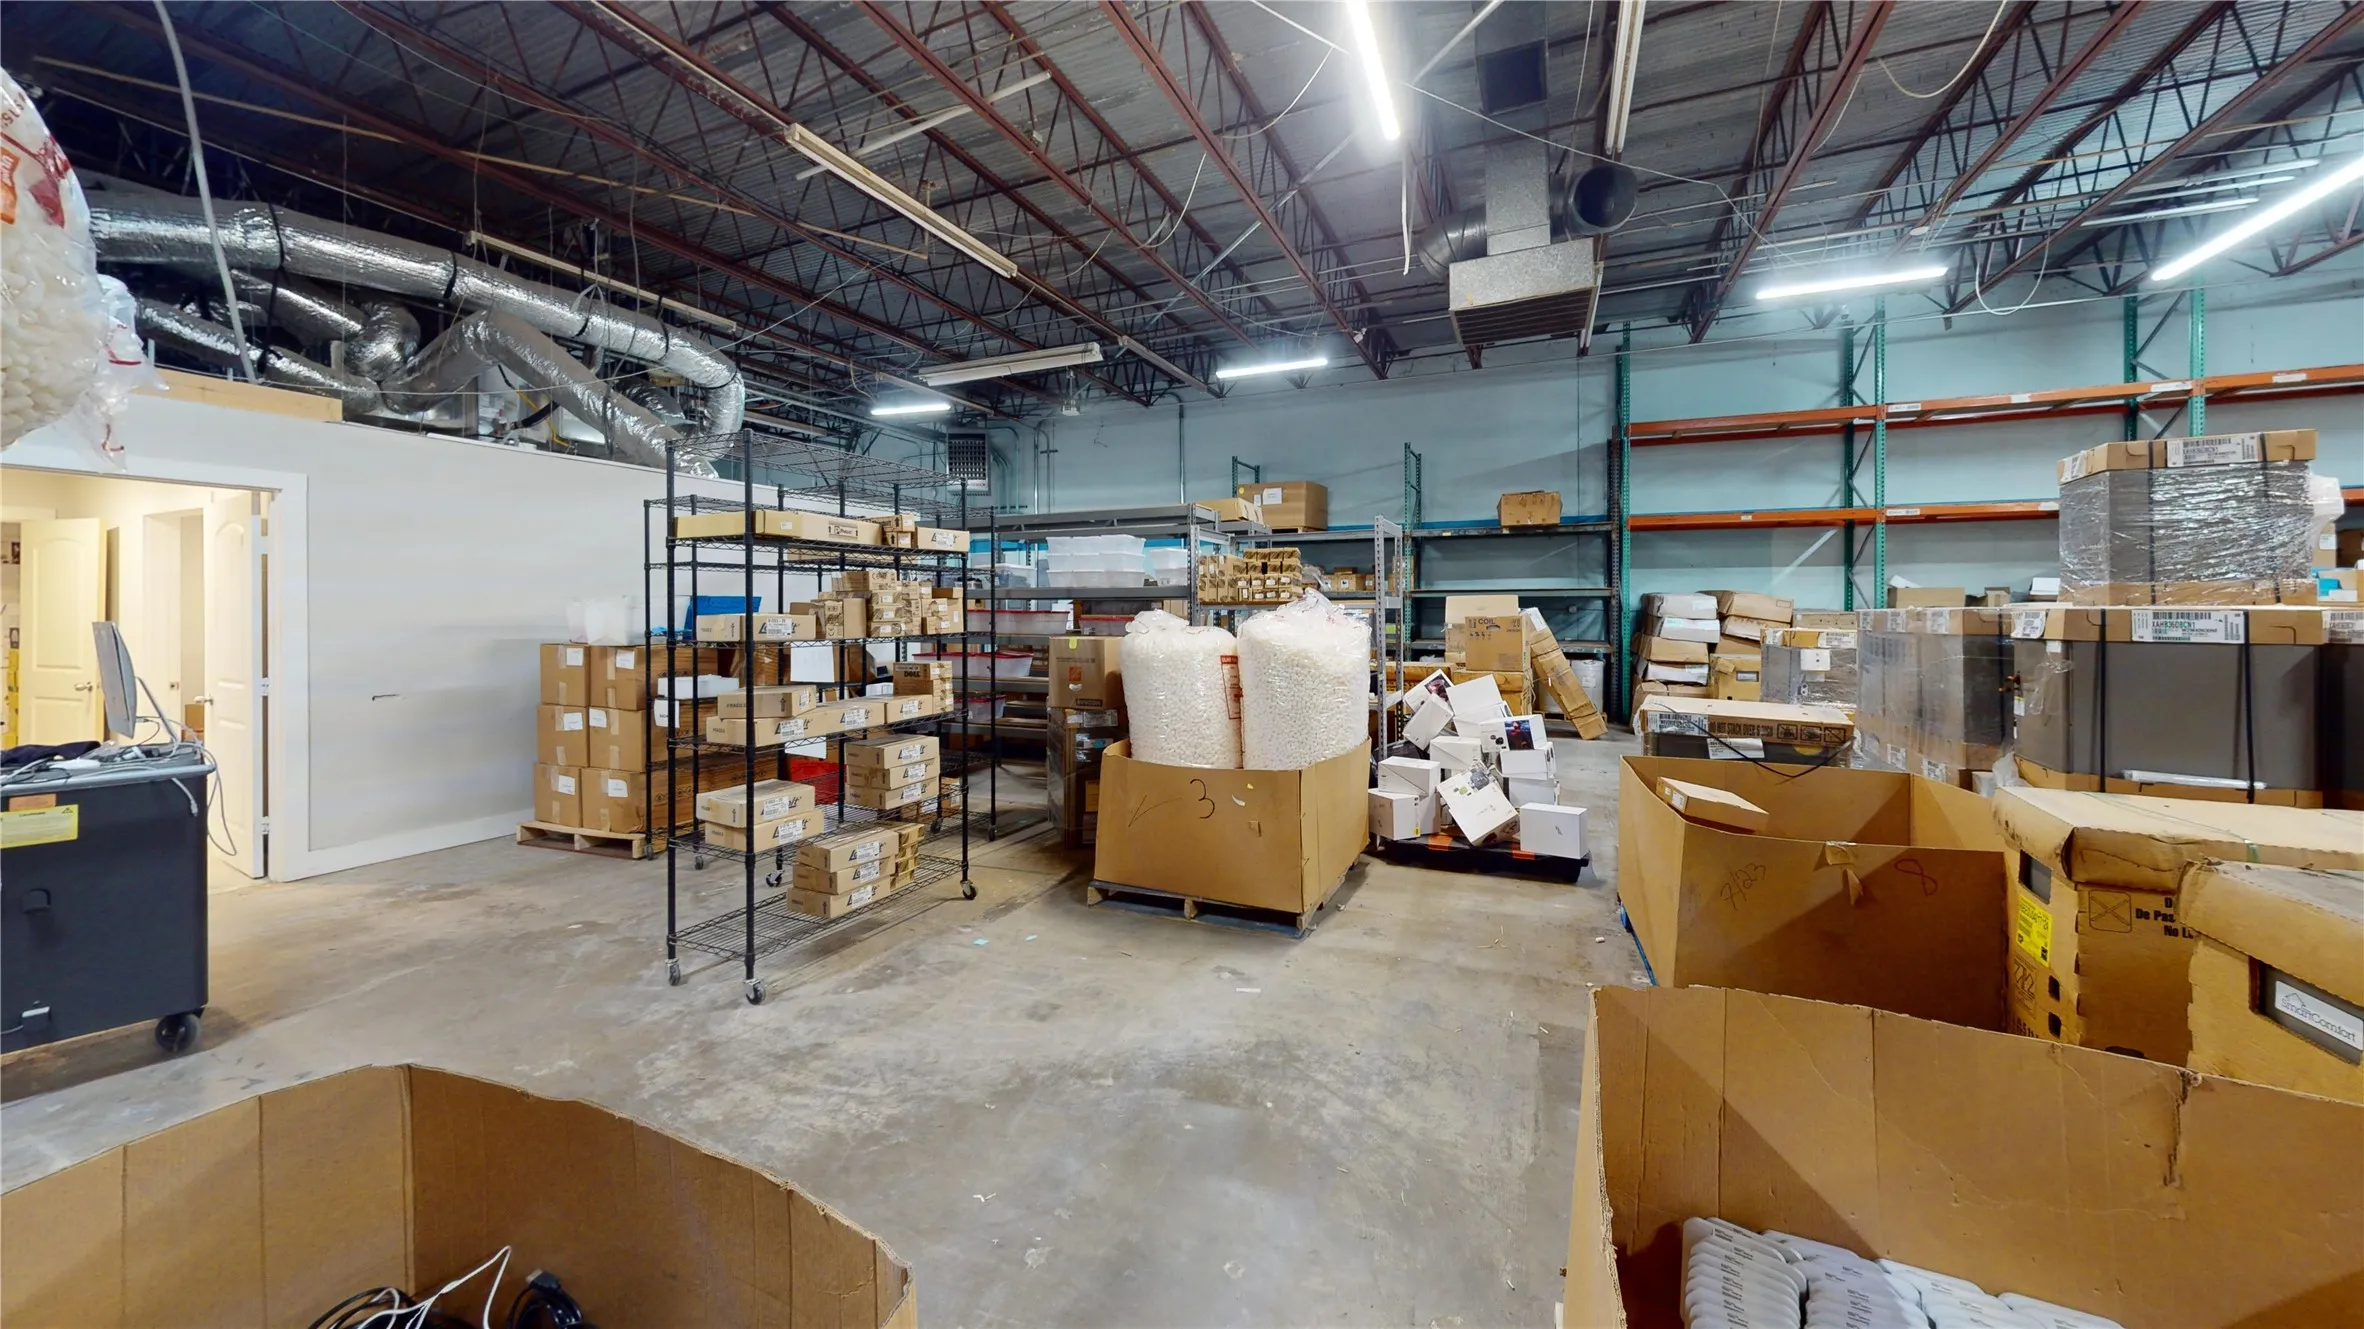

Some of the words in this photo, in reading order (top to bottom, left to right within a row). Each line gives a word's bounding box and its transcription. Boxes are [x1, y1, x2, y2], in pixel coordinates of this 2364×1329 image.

[904, 670, 921, 678] DELL
[1727, 722, 1742, 736] STACK
[1190, 778, 1215, 819] 3
[1894, 858, 1938, 896] 8
